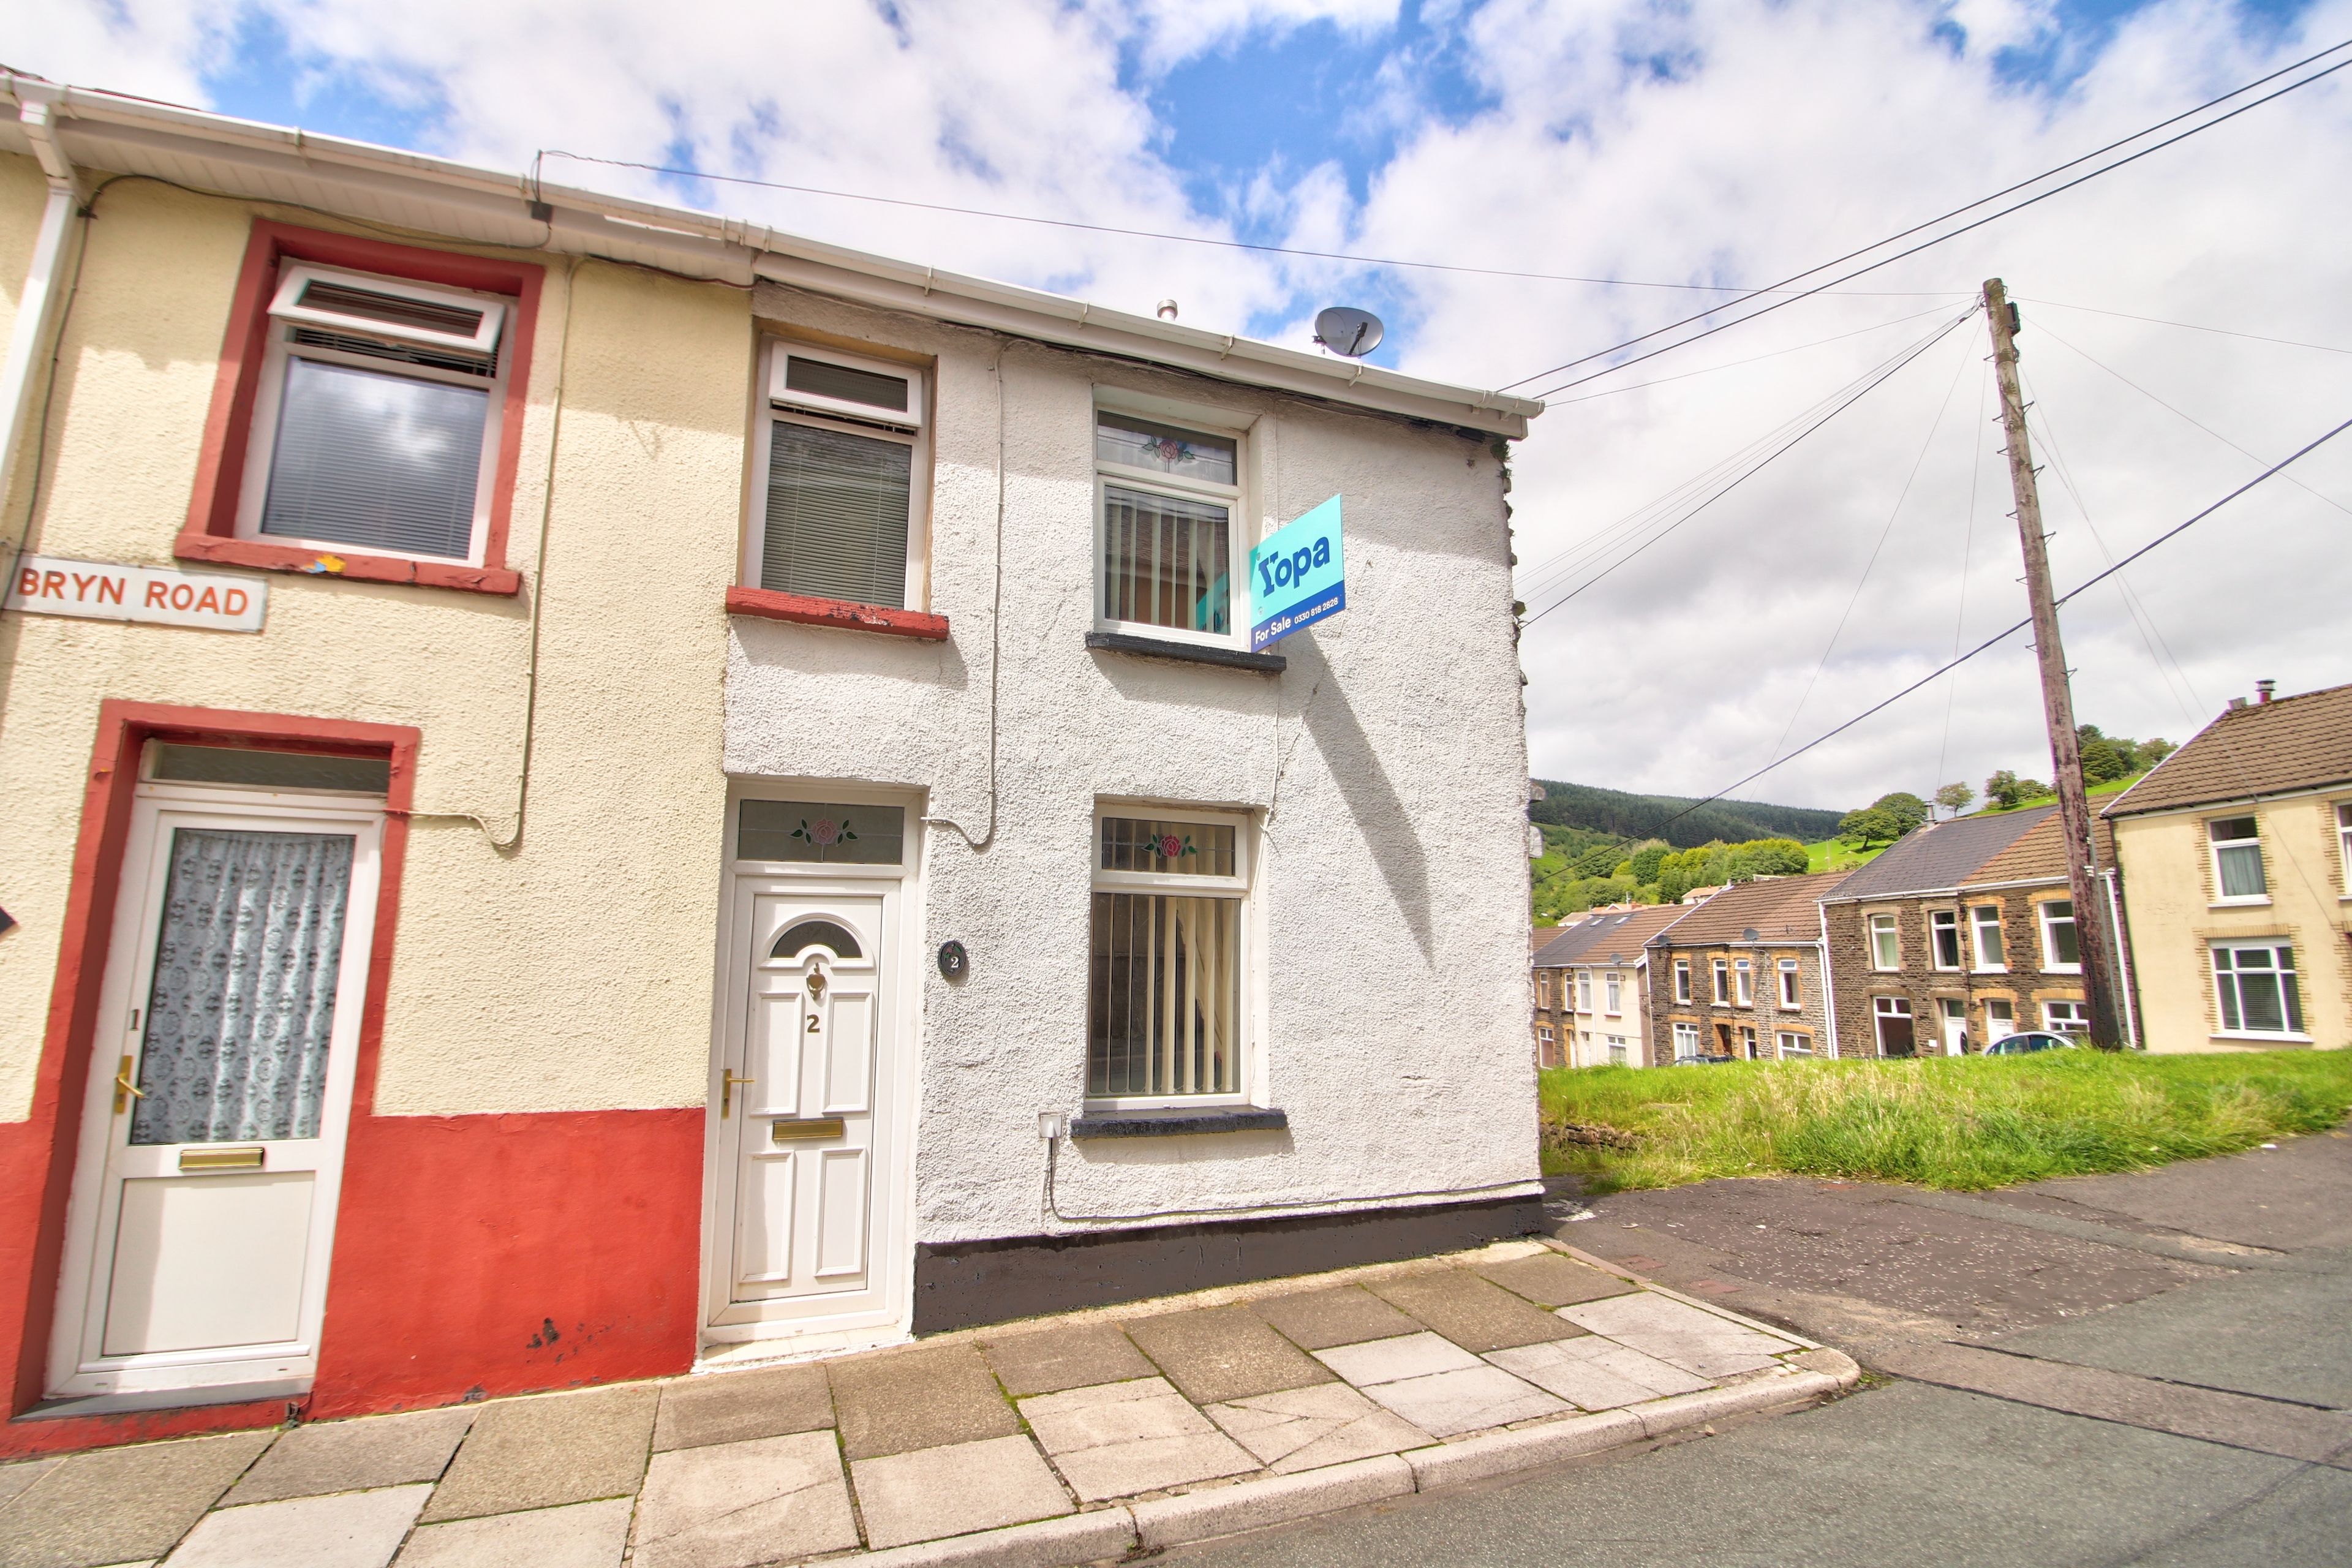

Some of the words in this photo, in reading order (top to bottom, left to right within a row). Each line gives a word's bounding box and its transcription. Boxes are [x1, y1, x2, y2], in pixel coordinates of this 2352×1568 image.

[17, 567, 126, 605] BRYN
[144, 581, 249, 616] ROAD
[1258, 537, 1330, 598] Yopa
[1255, 627, 1269, 645] For
[1270, 617, 1291, 636] Sale
[1294, 611, 1310, 624] 0330
[1311, 606, 1322, 616] 818
[1322, 597, 1338, 611] 2828
[951, 956, 959, 968] 2
[807, 1014, 820, 1033] 2
